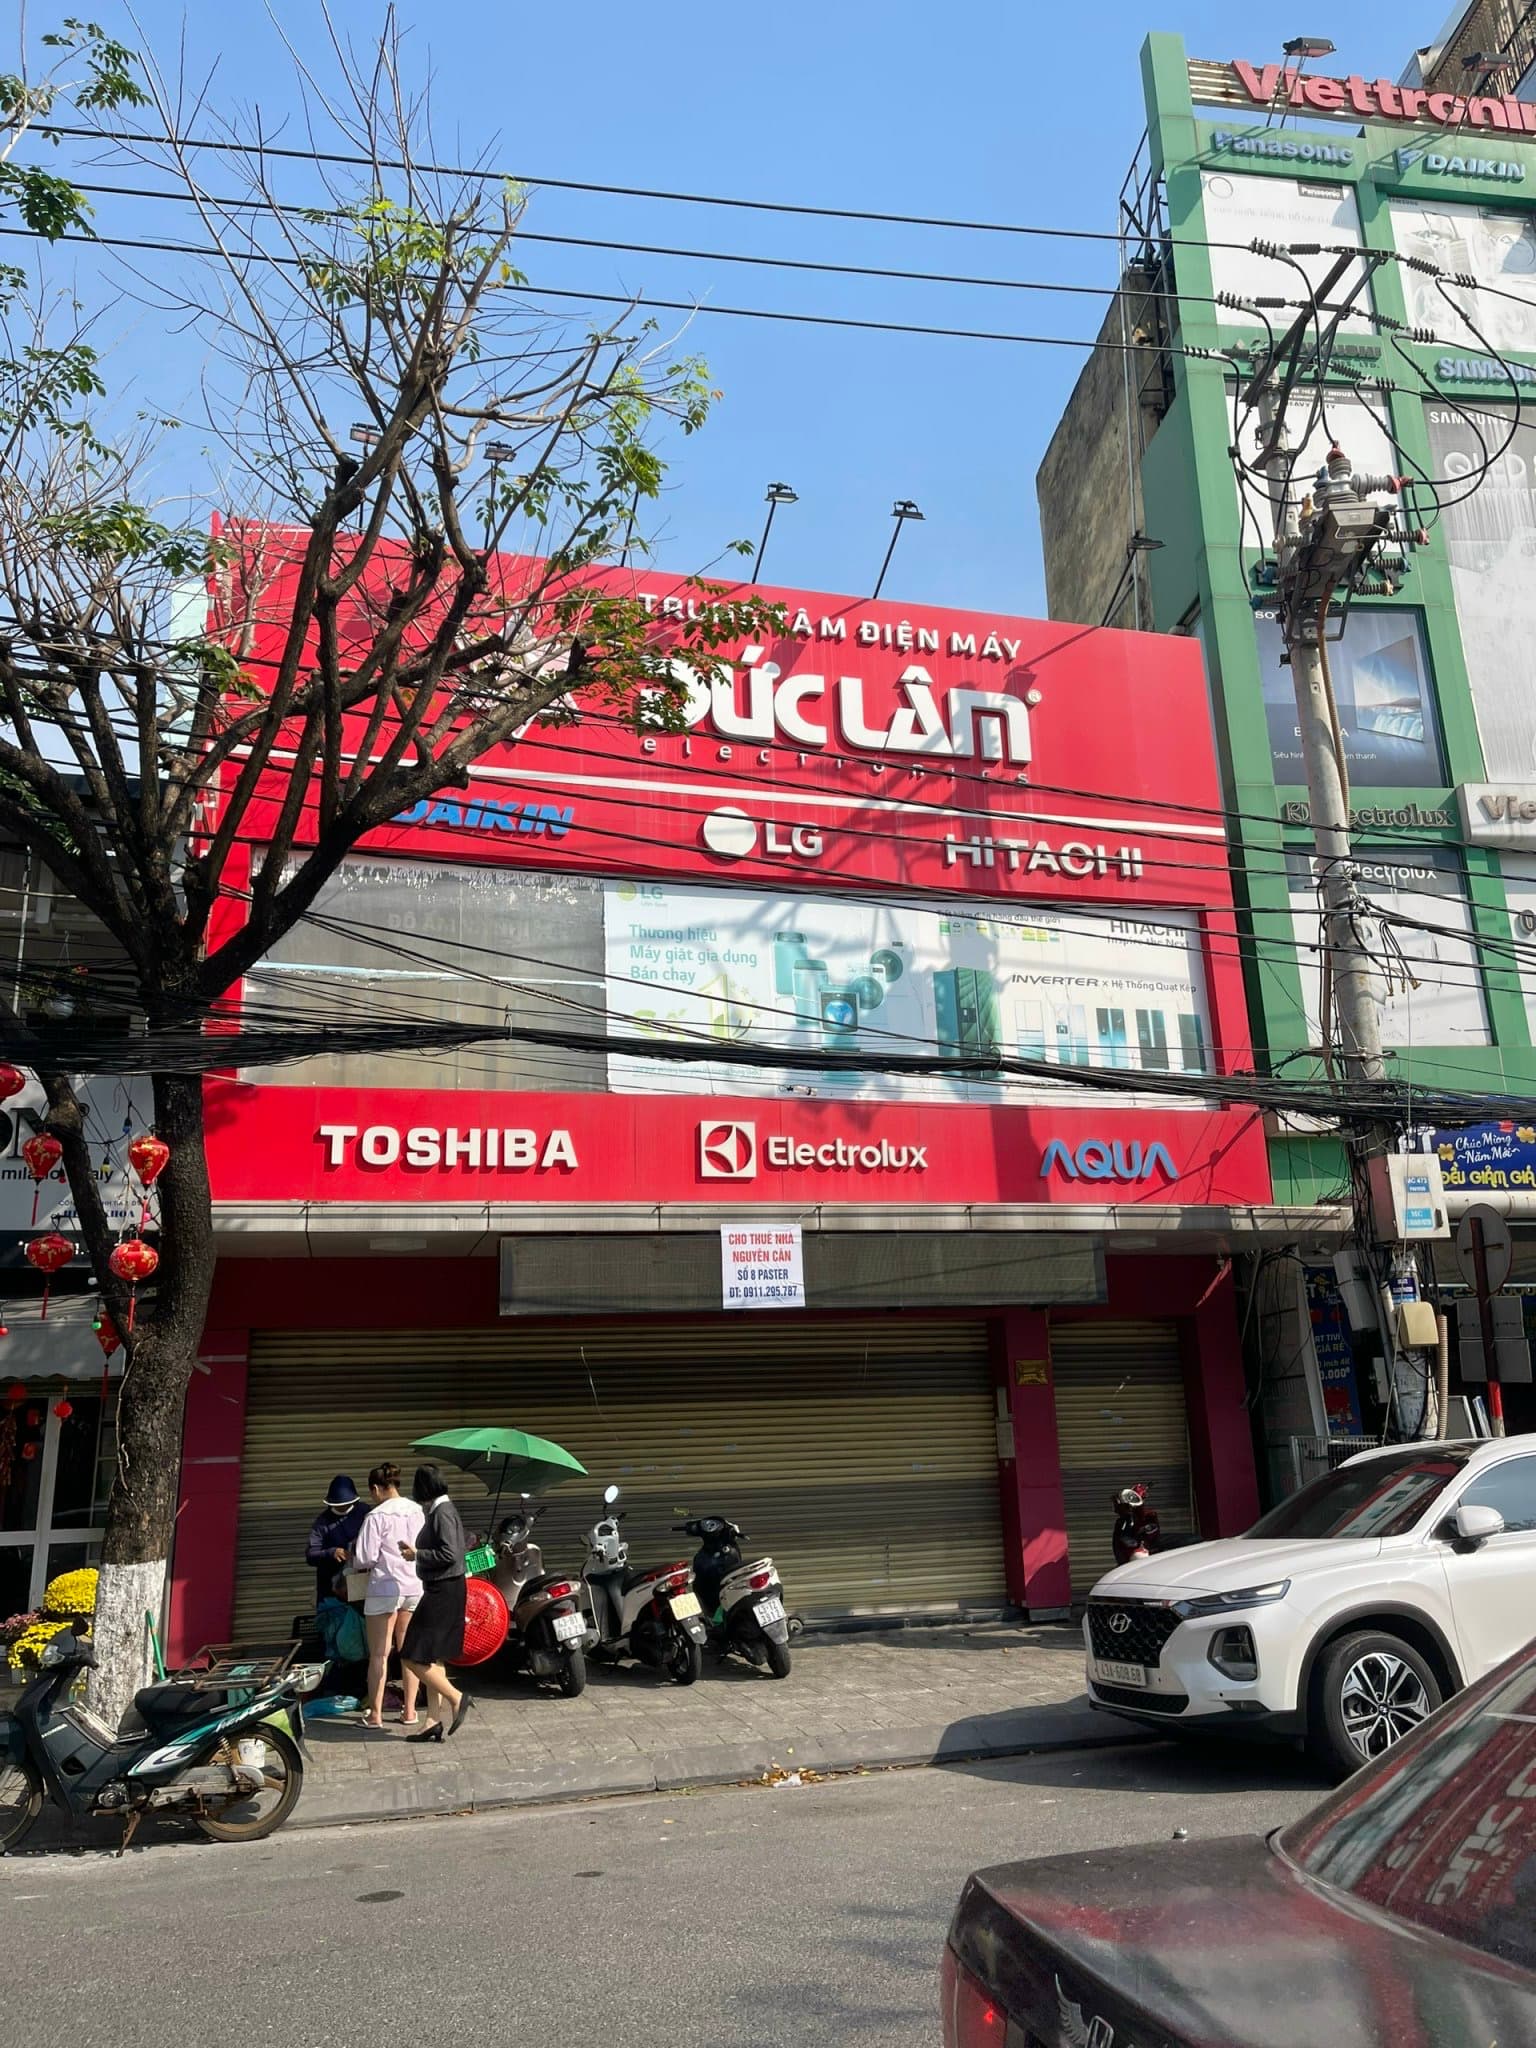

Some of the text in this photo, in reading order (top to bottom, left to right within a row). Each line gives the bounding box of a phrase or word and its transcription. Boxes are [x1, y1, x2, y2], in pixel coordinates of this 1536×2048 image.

[1213, 130, 1354, 164] Panasonic
[1425, 153, 1526, 179] DAIKIN
[860, 619, 940, 651] ĐIỆN
[950, 630, 1023, 660] MÁY
[1349, 803, 1457, 827] ectrolux
[766, 819, 824, 859] LG
[945, 833, 1144, 879] HITACHI
[640, 885, 664, 900] LG
[687, 927, 718, 942] hiệu
[630, 945, 661, 963] Máy
[698, 949, 718, 966] gia
[723, 949, 757, 967] dụng
[630, 965, 696, 986] Bán chạy
[1011, 974, 1099, 988] INVERTER
[320, 1124, 579, 1169] TOSHIBA
[767, 1135, 930, 1170] Electrolux
[1455, 1137, 1482, 1151] Chúc
[1040, 1138, 1180, 1180] AQUA
[1, 1168, 59, 1181] milao
[1469, 1164, 1510, 1188] GIẢM
[728, 1229, 795, 1246] CHO THUÊ NHÀ
[732, 1247, 770, 1263] NGUYÊN
[737, 1265, 789, 1281] SỐ 8 PASTER
[743, 1285, 798, 1298] 0911.295.787
